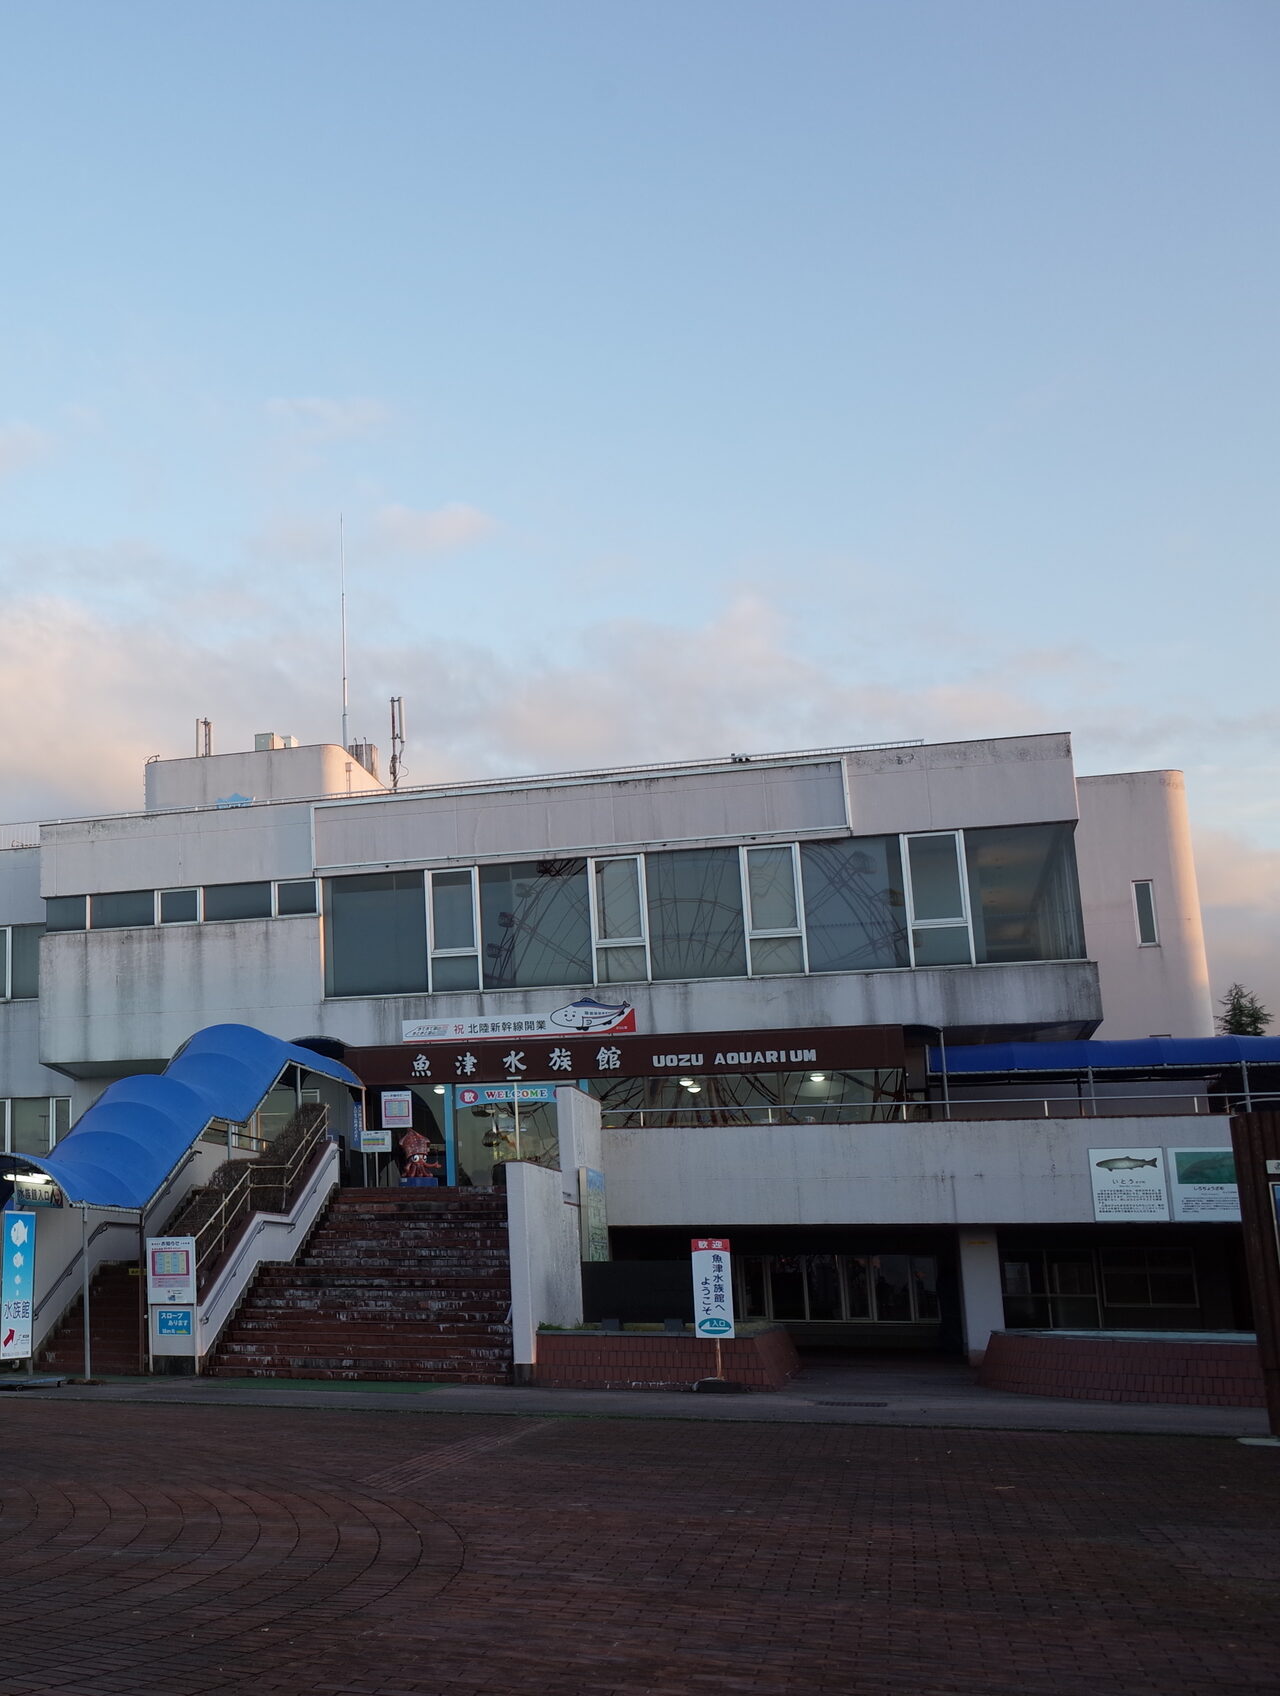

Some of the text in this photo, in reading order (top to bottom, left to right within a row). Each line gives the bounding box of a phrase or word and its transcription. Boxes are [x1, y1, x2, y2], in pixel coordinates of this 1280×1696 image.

[454, 1024, 465, 1035] 祝
[468, 1020, 547, 1035] 北陸新幹線開業
[411, 1046, 622, 1077] 魚津水族館
[652, 1048, 817, 1067] UOZU AQUARIUM
[485, 1088, 548, 1100] WELCOME
[698, 1240, 723, 1249] 歓迎
[712, 1254, 725, 1311] 魚津水族館へ
[701, 1276, 712, 1316] ようこそ
[3, 1300, 30, 1320] 水族館
